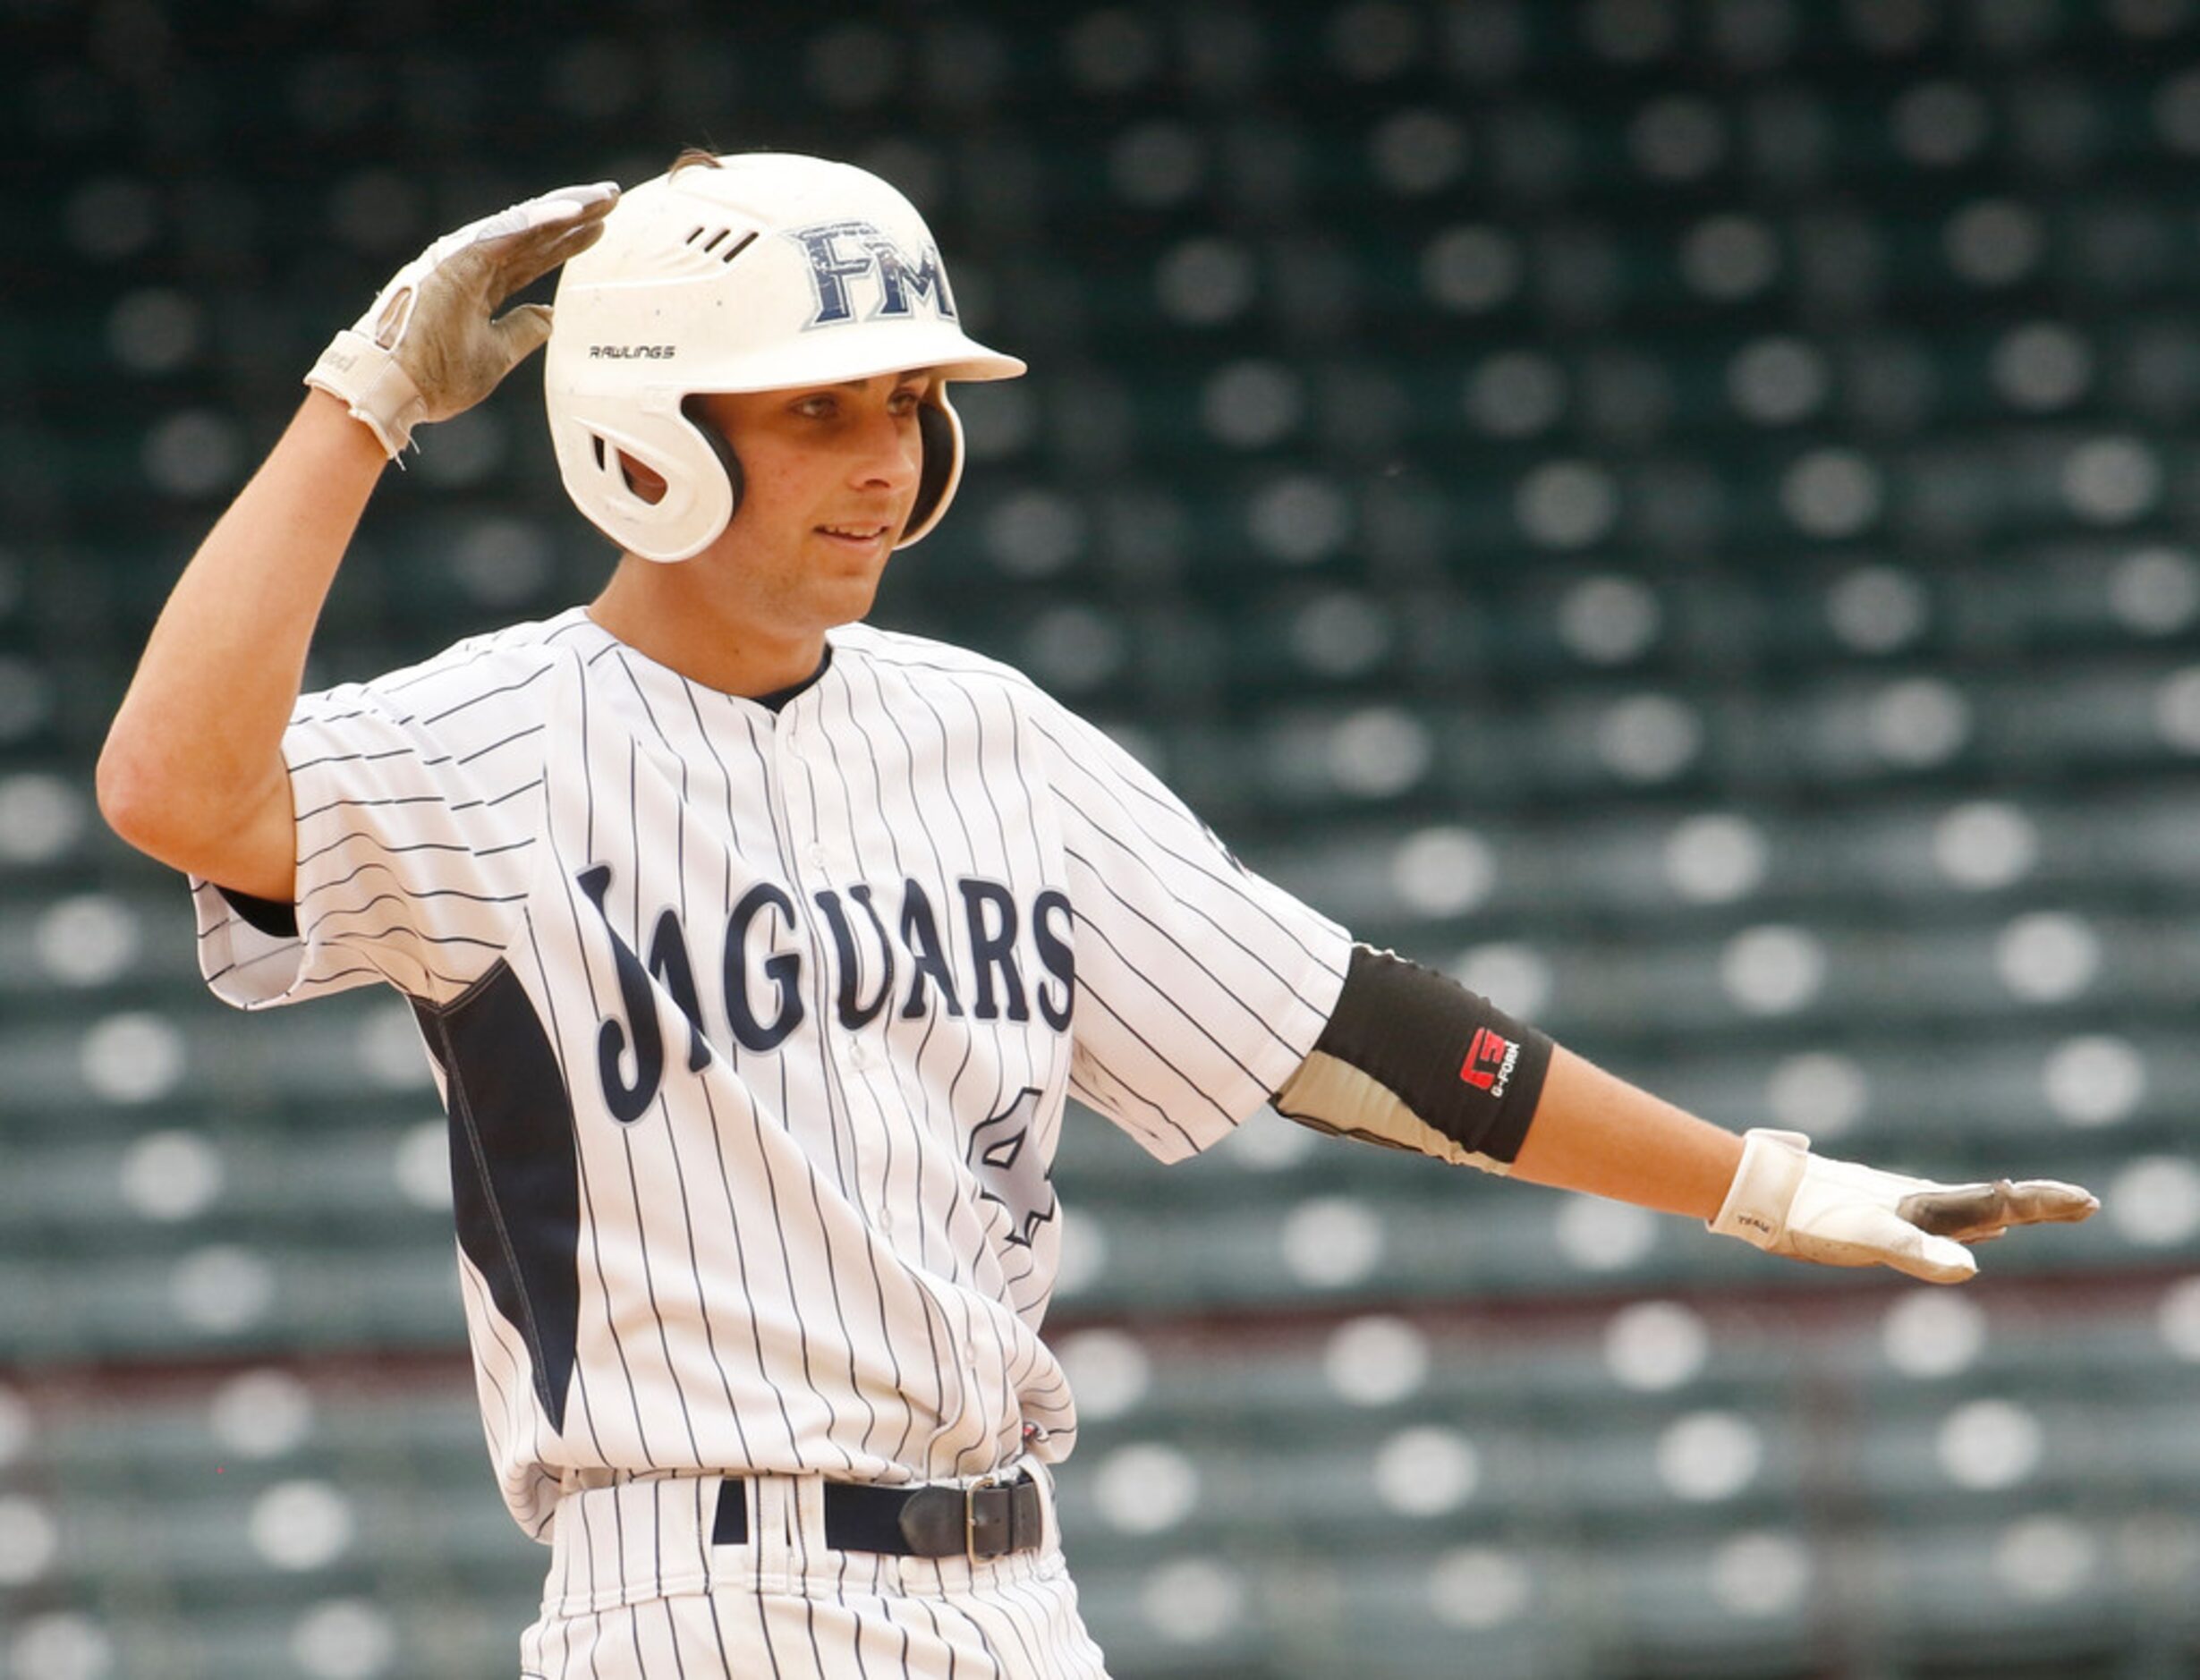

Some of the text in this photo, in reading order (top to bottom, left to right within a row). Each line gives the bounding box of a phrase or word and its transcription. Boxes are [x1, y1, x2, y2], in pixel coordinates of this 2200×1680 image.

[782, 219, 958, 332] FM
[590, 345, 675, 359] RAWLINGS
[575, 861, 1075, 1127] JAGUARS
